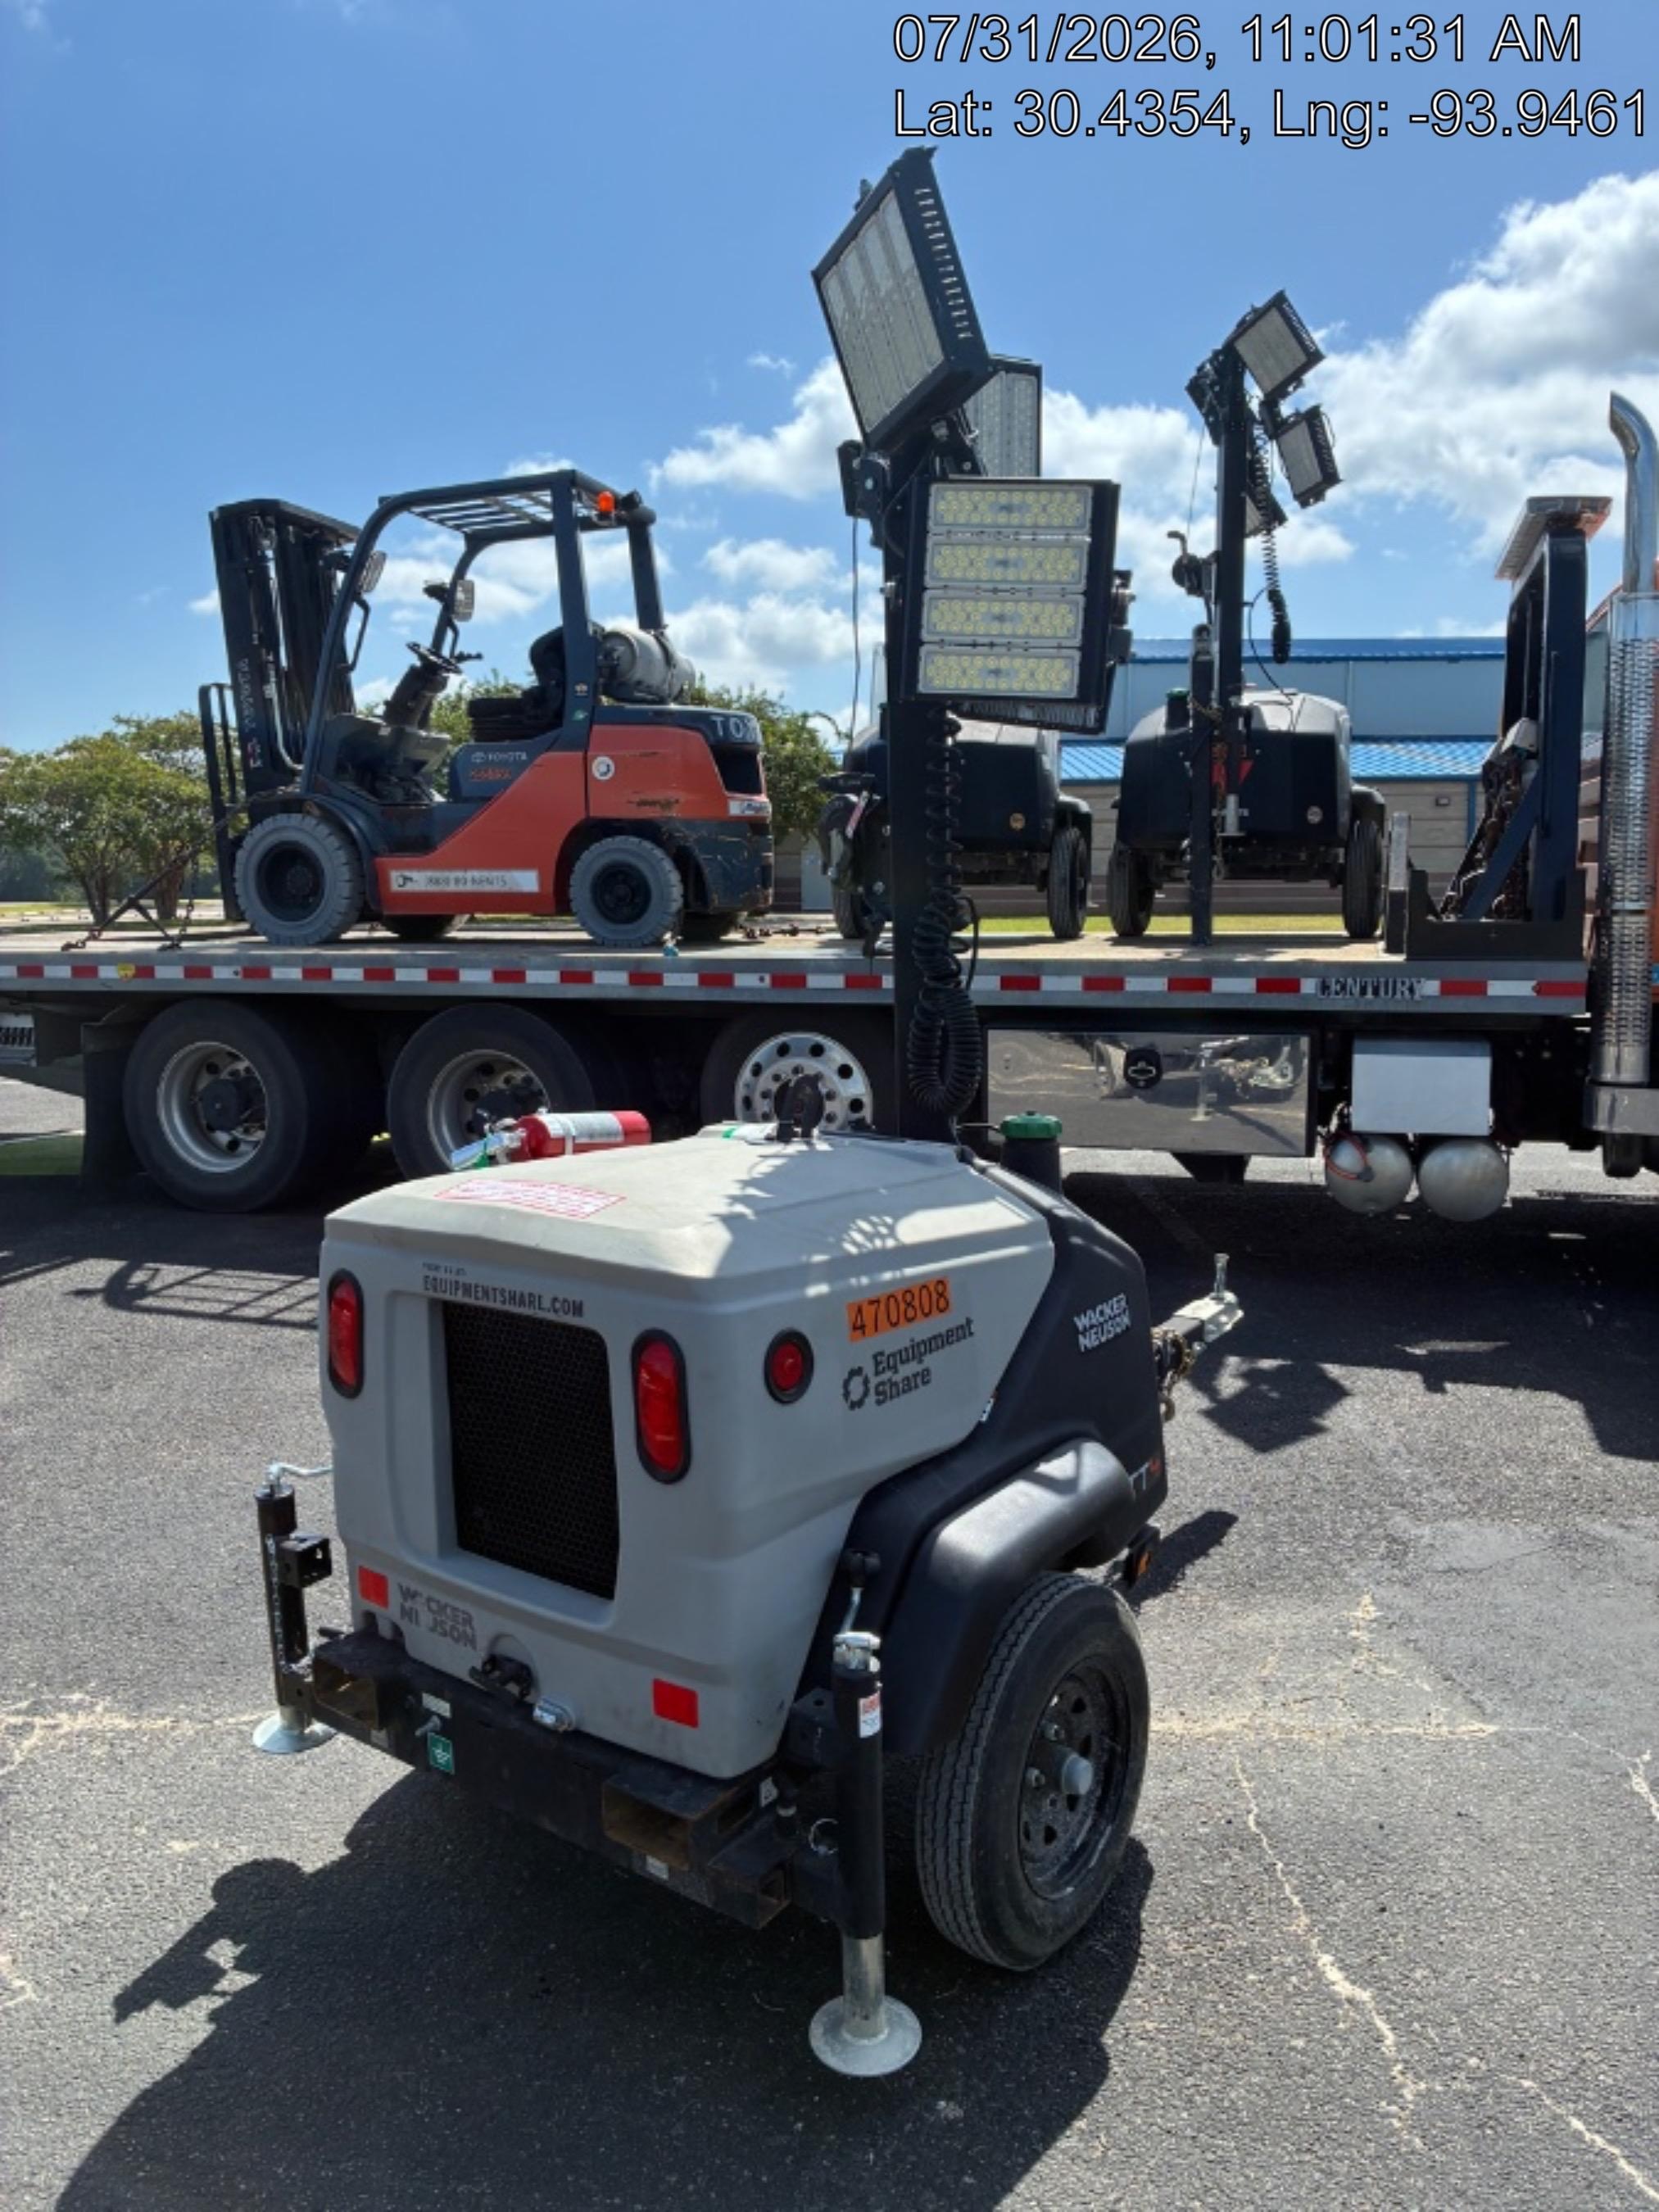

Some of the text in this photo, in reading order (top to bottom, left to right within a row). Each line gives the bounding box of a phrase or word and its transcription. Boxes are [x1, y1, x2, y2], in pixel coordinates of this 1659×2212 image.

[1316, 977, 1426, 1001] CENTURY
[852, 1280, 950, 1337] 470808
[1073, 1292, 1128, 1331] WACKER
[1077, 1308, 1131, 1352] NEUSON
[872, 1316, 975, 1377] Equipment
[873, 1367, 932, 1407] Share
[397, 1582, 473, 1629] WCKER
